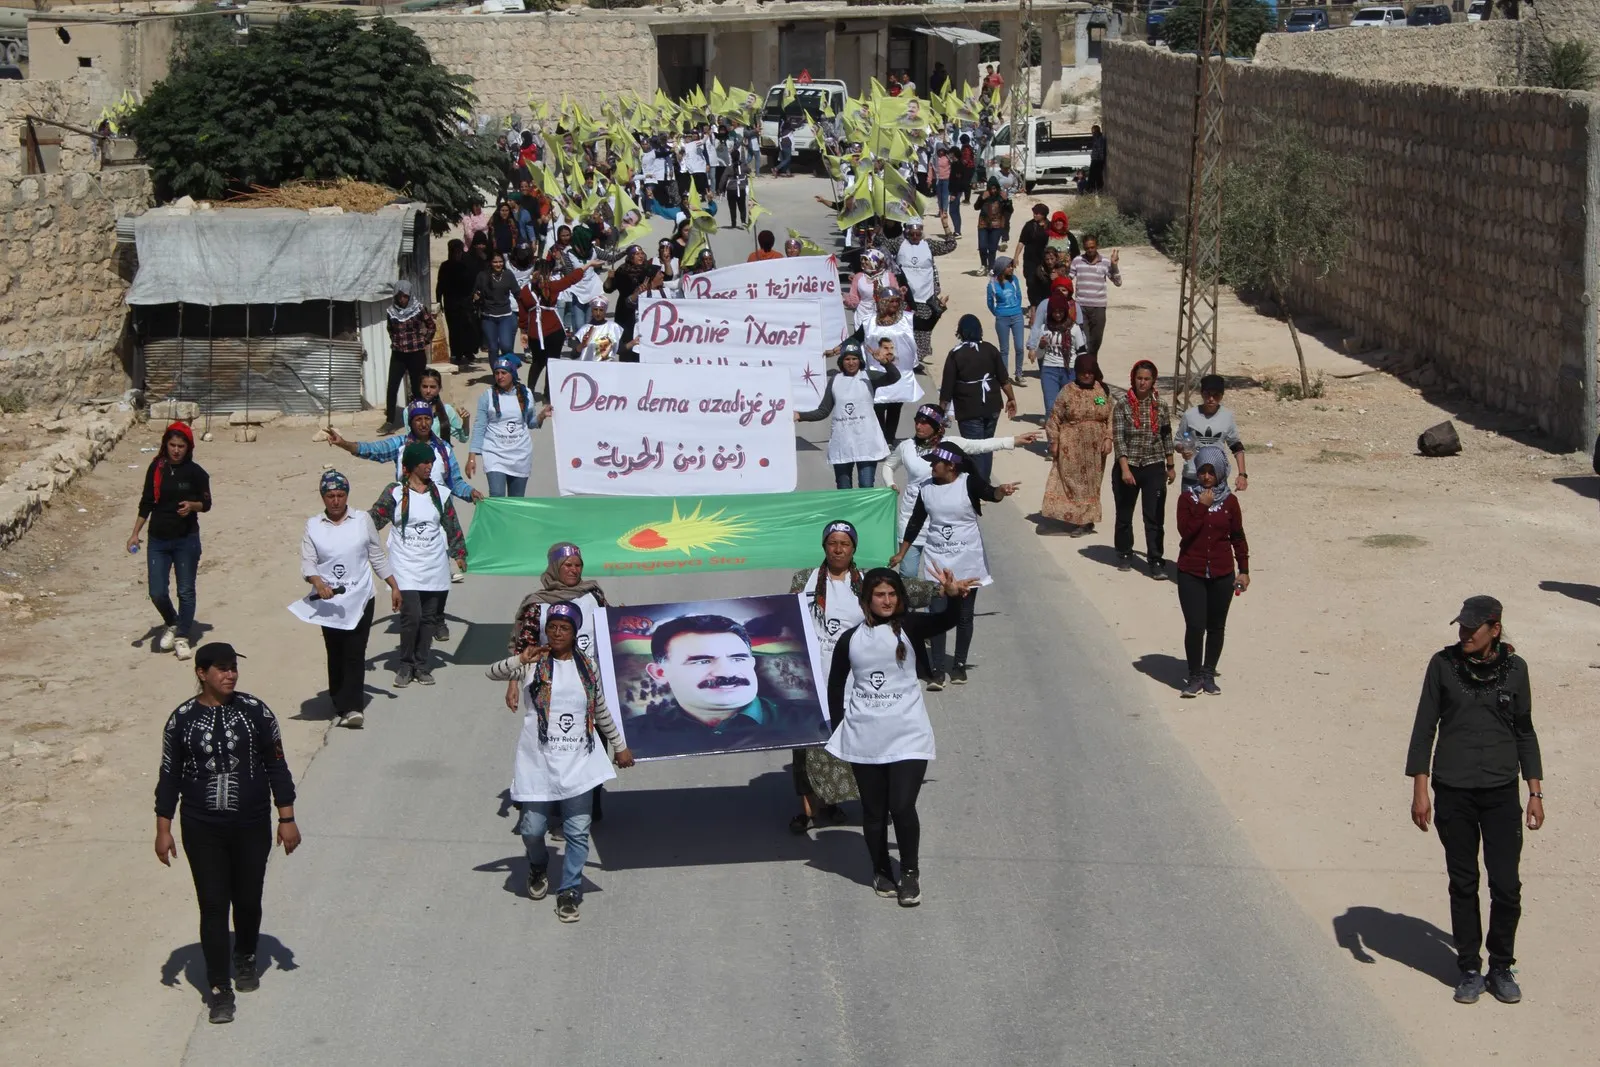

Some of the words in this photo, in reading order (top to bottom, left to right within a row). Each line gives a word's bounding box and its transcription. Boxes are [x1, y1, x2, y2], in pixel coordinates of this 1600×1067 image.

[560, 372, 628, 412] Dem
[637, 379, 690, 413] dema
[673, 442, 706, 472] زمن
[712, 444, 746, 471] زمن
